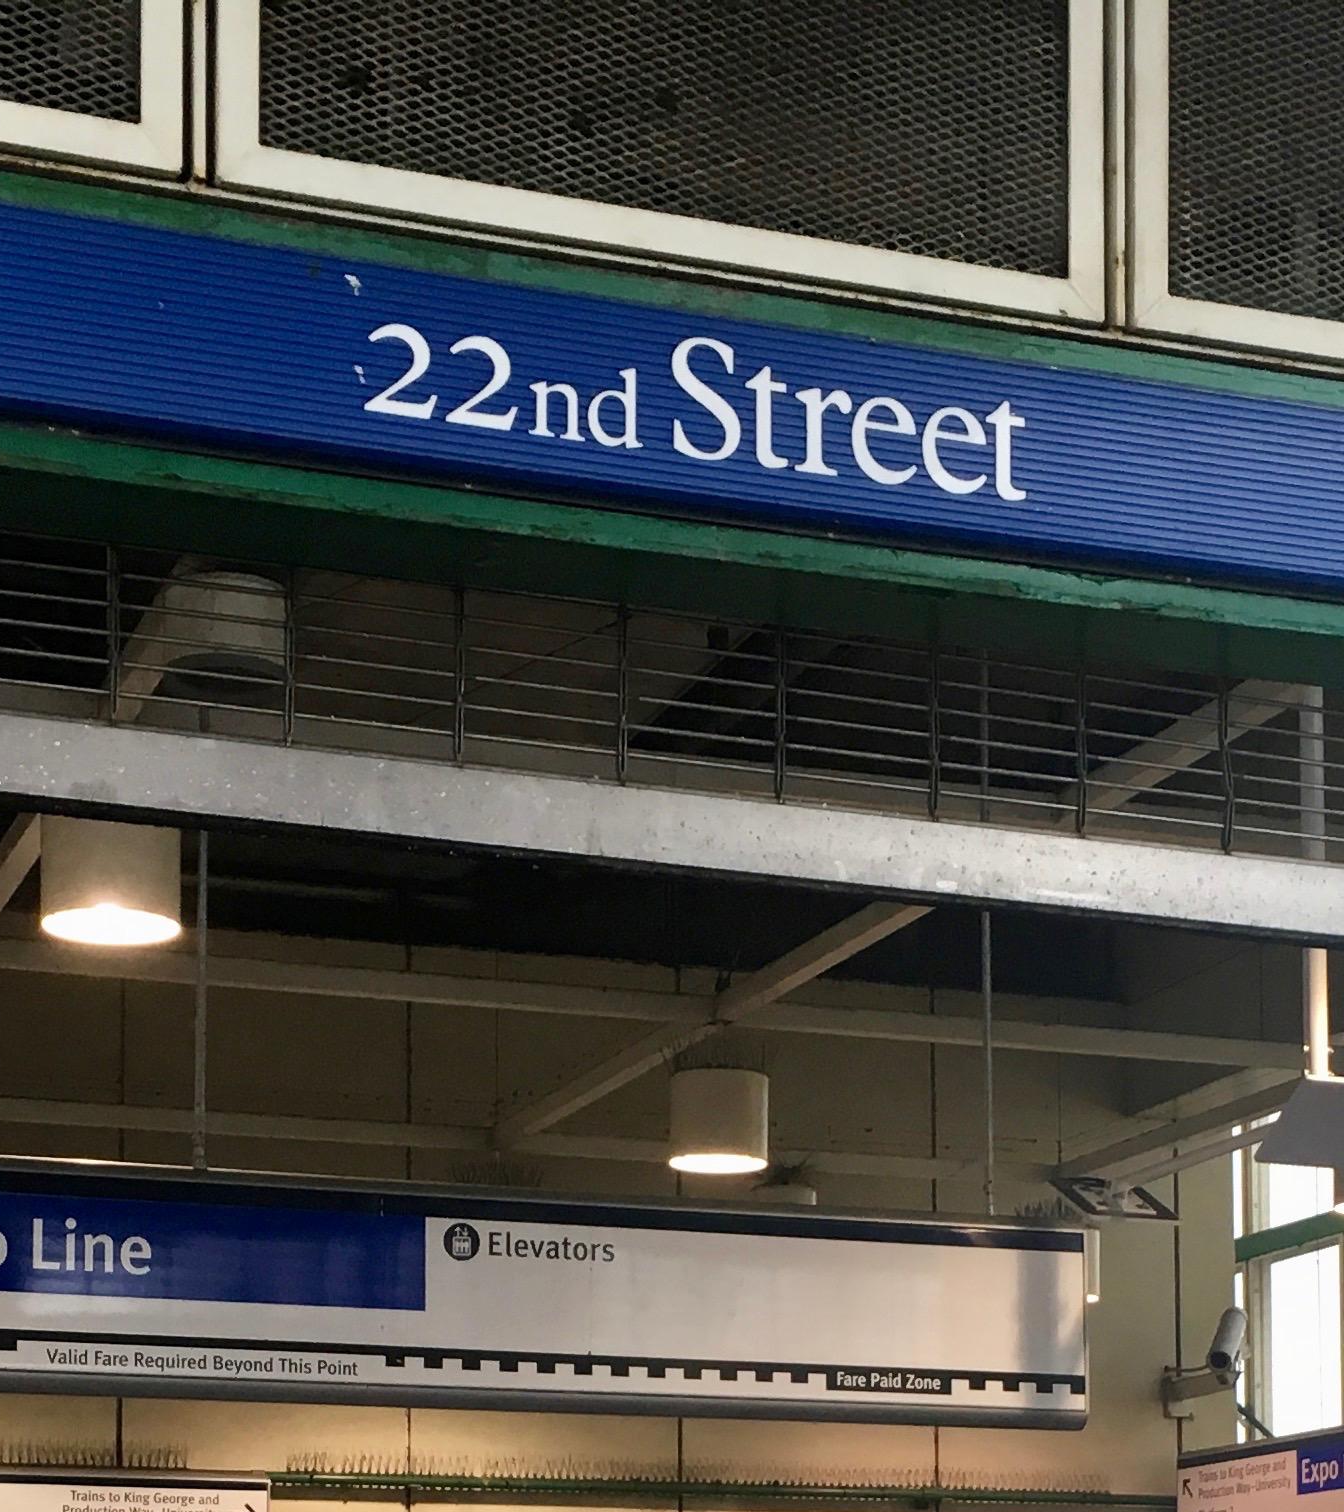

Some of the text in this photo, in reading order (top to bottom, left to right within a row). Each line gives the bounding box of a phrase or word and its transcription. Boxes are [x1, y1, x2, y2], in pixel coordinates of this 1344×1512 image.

[364, 322, 1027, 501] 22nd Street
[32, 1217, 152, 1276] Line
[487, 1231, 615, 1265] Elevators
[46, 1348, 359, 1376] Valid Fare Required Beyond This Point
[836, 1371, 942, 1392] Fare Paid Zone
[1301, 1456, 1339, 1488] Expo
[70, 1489, 220, 1508] Trains to King George and
